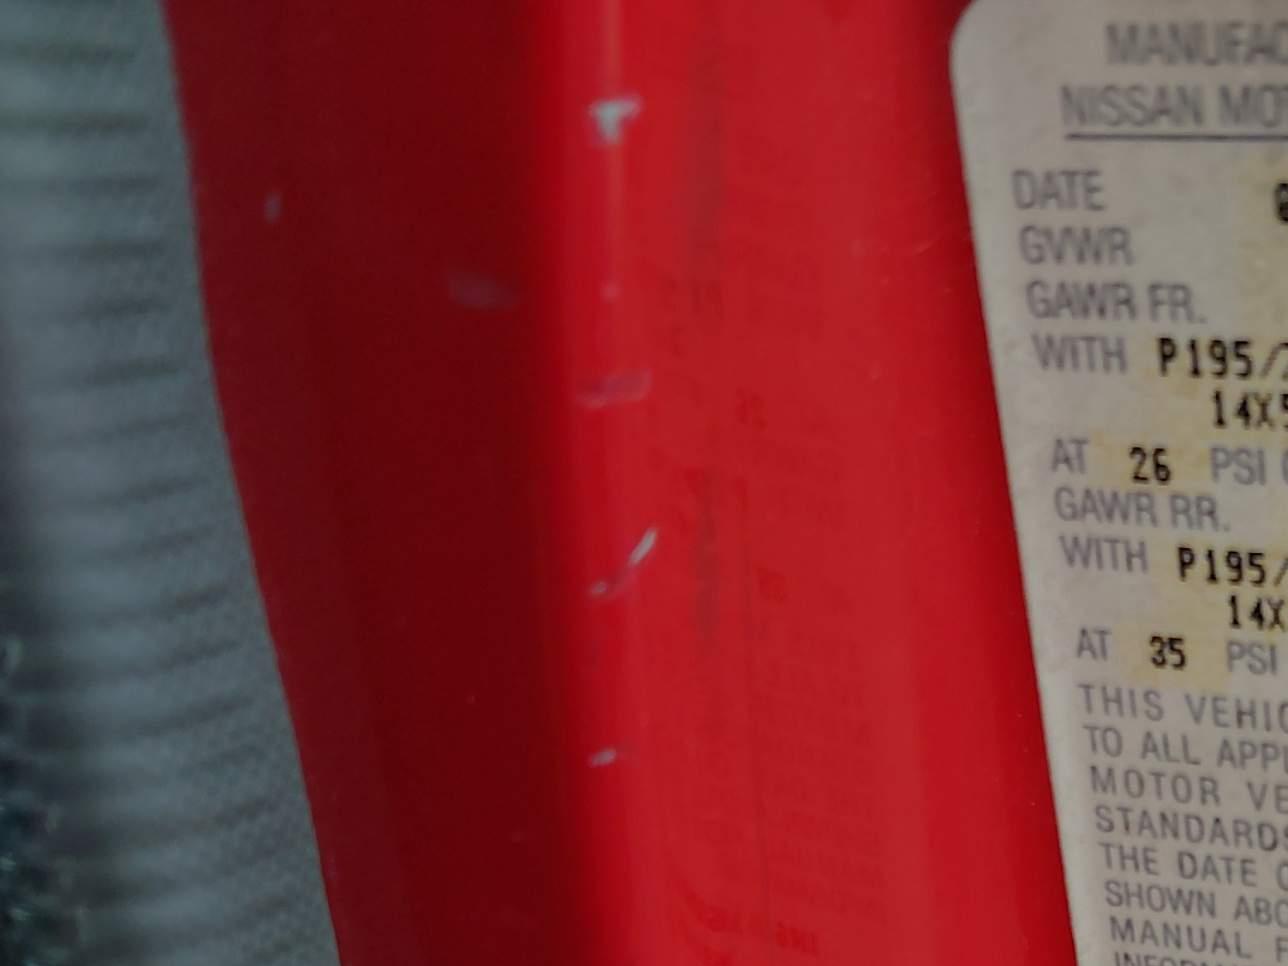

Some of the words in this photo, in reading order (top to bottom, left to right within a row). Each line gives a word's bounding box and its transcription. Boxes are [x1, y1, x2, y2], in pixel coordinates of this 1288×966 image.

[1061, 84, 1205, 127] NISSAN
[1011, 169, 1106, 211] DATE
[1018, 225, 1133, 267] GVWR
[1025, 280, 1136, 320] GAWR
[1149, 284, 1206, 324] FR.
[1031, 334, 1128, 375] WITH
[1051, 438, 1088, 473] AT
[1129, 445, 1171, 483] 26
[1210, 447, 1267, 485] PSI
[1053, 487, 1157, 526] GAWR
[1169, 494, 1230, 532] RR.
[1059, 535, 1148, 573] WITH
[1076, 629, 1111, 662] AT
[1149, 636, 1187, 669] 35
[1226, 642, 1277, 675] PSI
[1078, 684, 1166, 721] THIS
[1082, 726, 1124, 758] TO
[1141, 731, 1200, 767] ALL
[1089, 766, 1221, 806] MOTOR
[1102, 842, 1160, 878] THE
[1178, 851, 1258, 889] DATE
[1104, 880, 1217, 920] SHOWN
[1109, 917, 1253, 960] MANUAL
